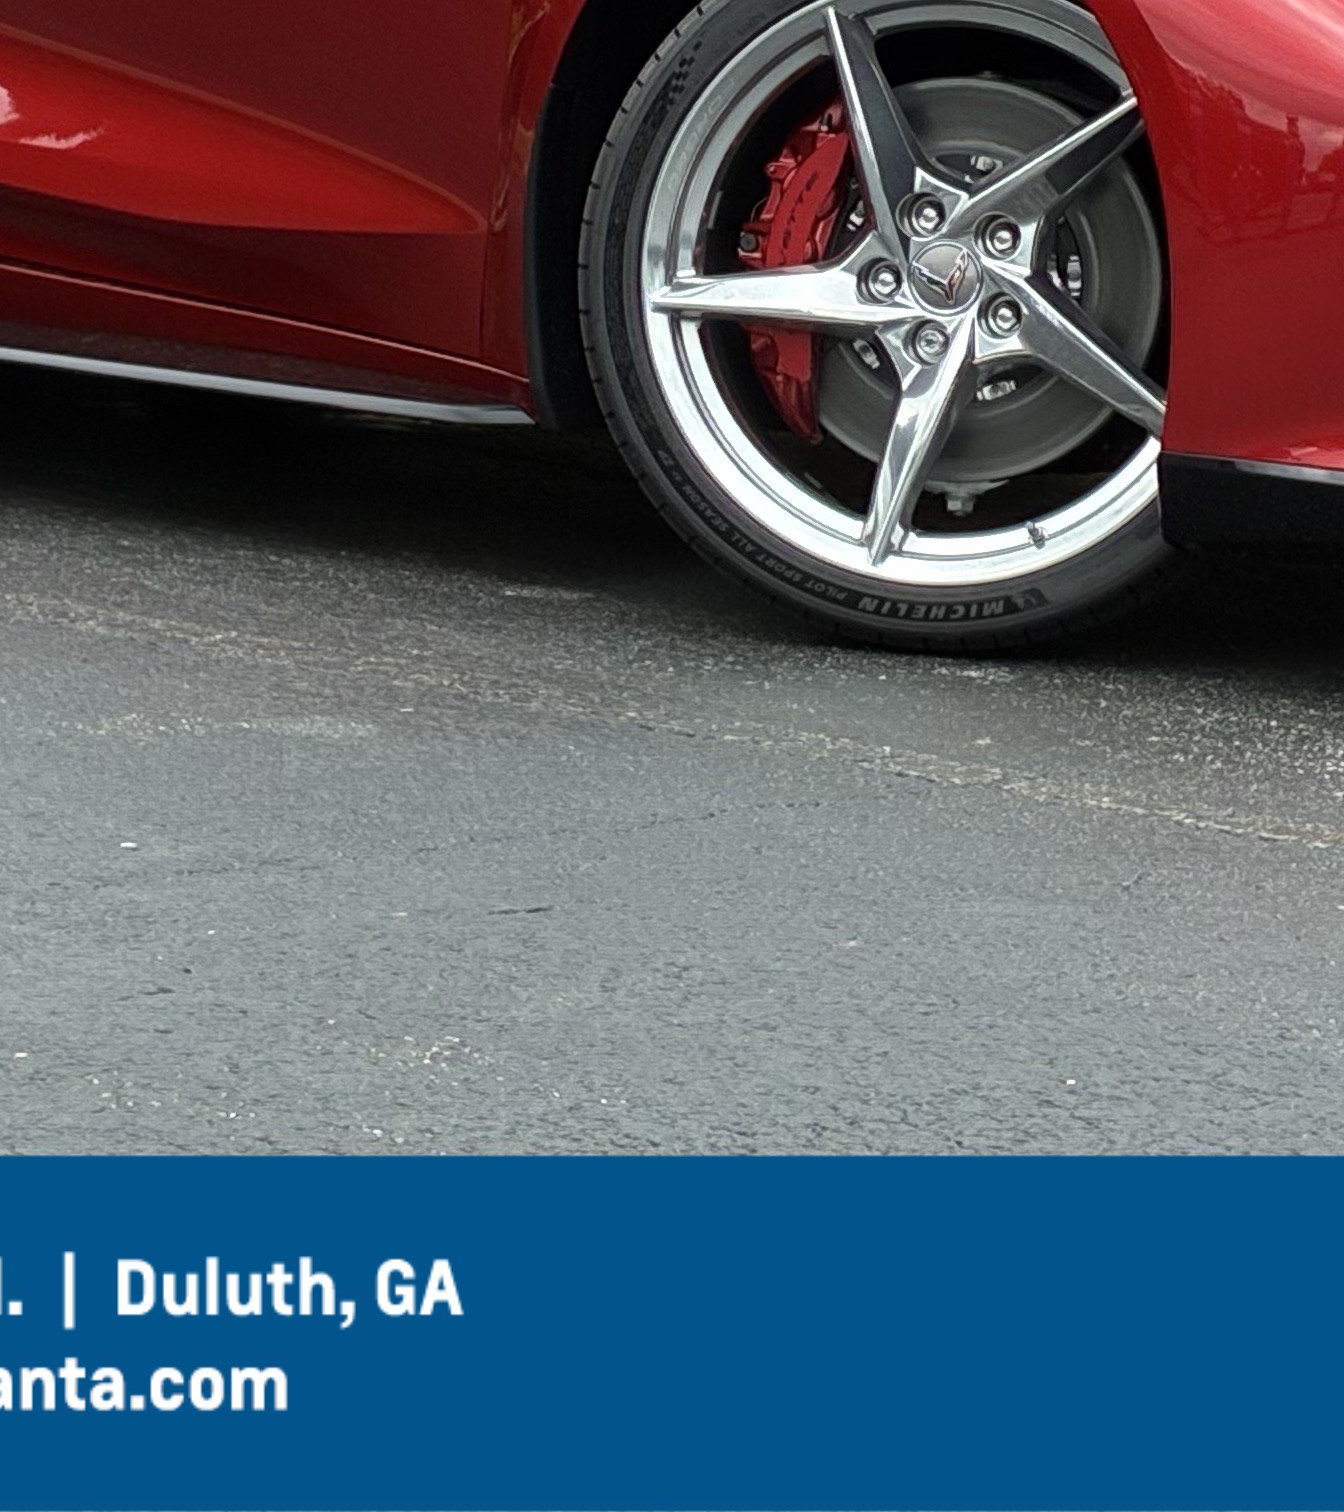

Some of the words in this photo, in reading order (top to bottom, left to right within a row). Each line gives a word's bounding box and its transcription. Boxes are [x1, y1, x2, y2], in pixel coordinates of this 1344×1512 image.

[680, 483, 730, 533] SEASON
[727, 531, 757, 554] ALL
[754, 553, 803, 583] SPORT
[803, 579, 848, 601] PILOT
[856, 594, 1005, 620] MICHELIN
